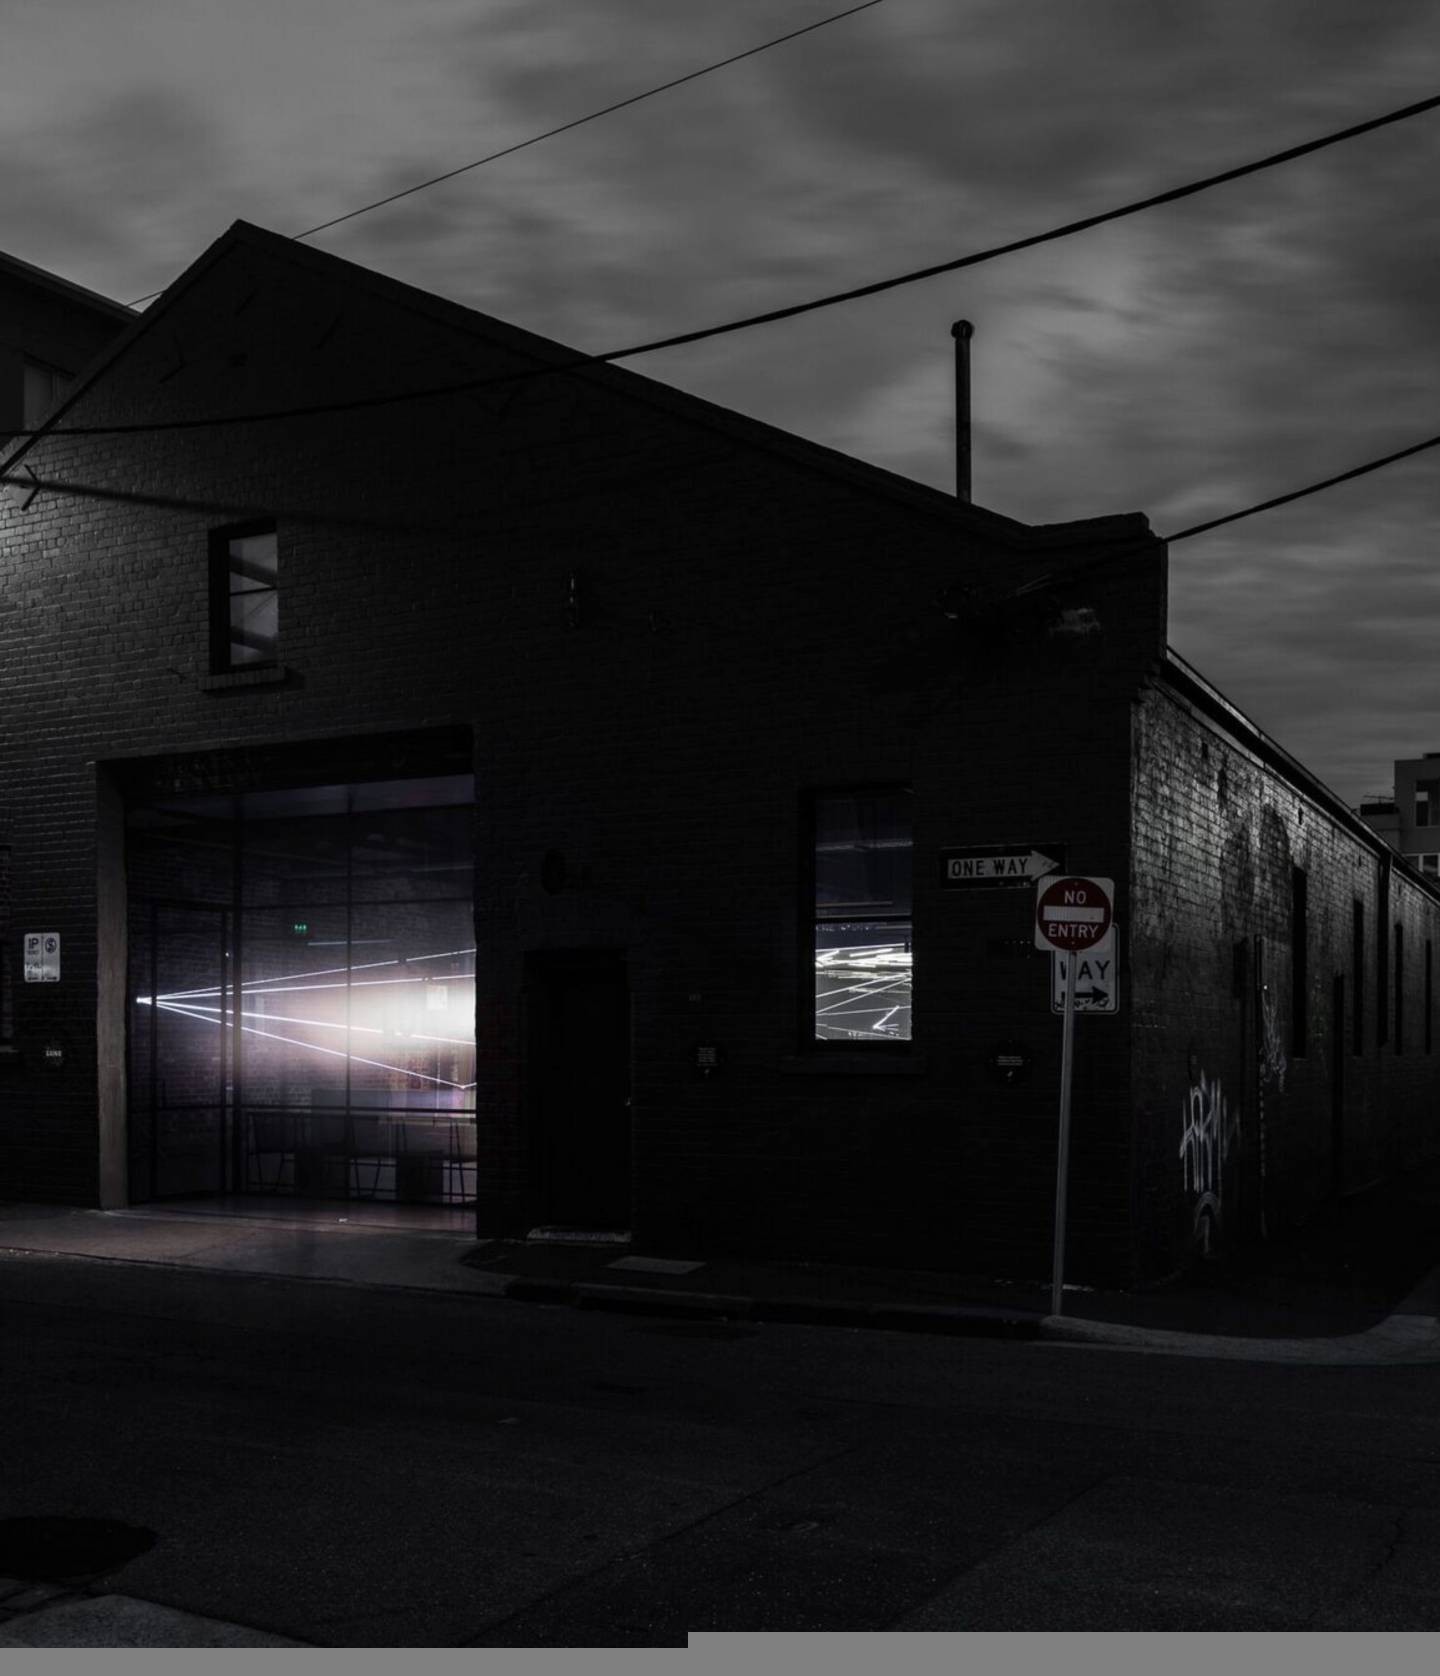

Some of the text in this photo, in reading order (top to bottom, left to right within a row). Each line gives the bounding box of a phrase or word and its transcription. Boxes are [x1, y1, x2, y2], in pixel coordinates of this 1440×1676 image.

[951, 857, 1029, 877] ONE WAY
[1064, 889, 1088, 905] NO
[1047, 922, 1099, 939] ENTRY
